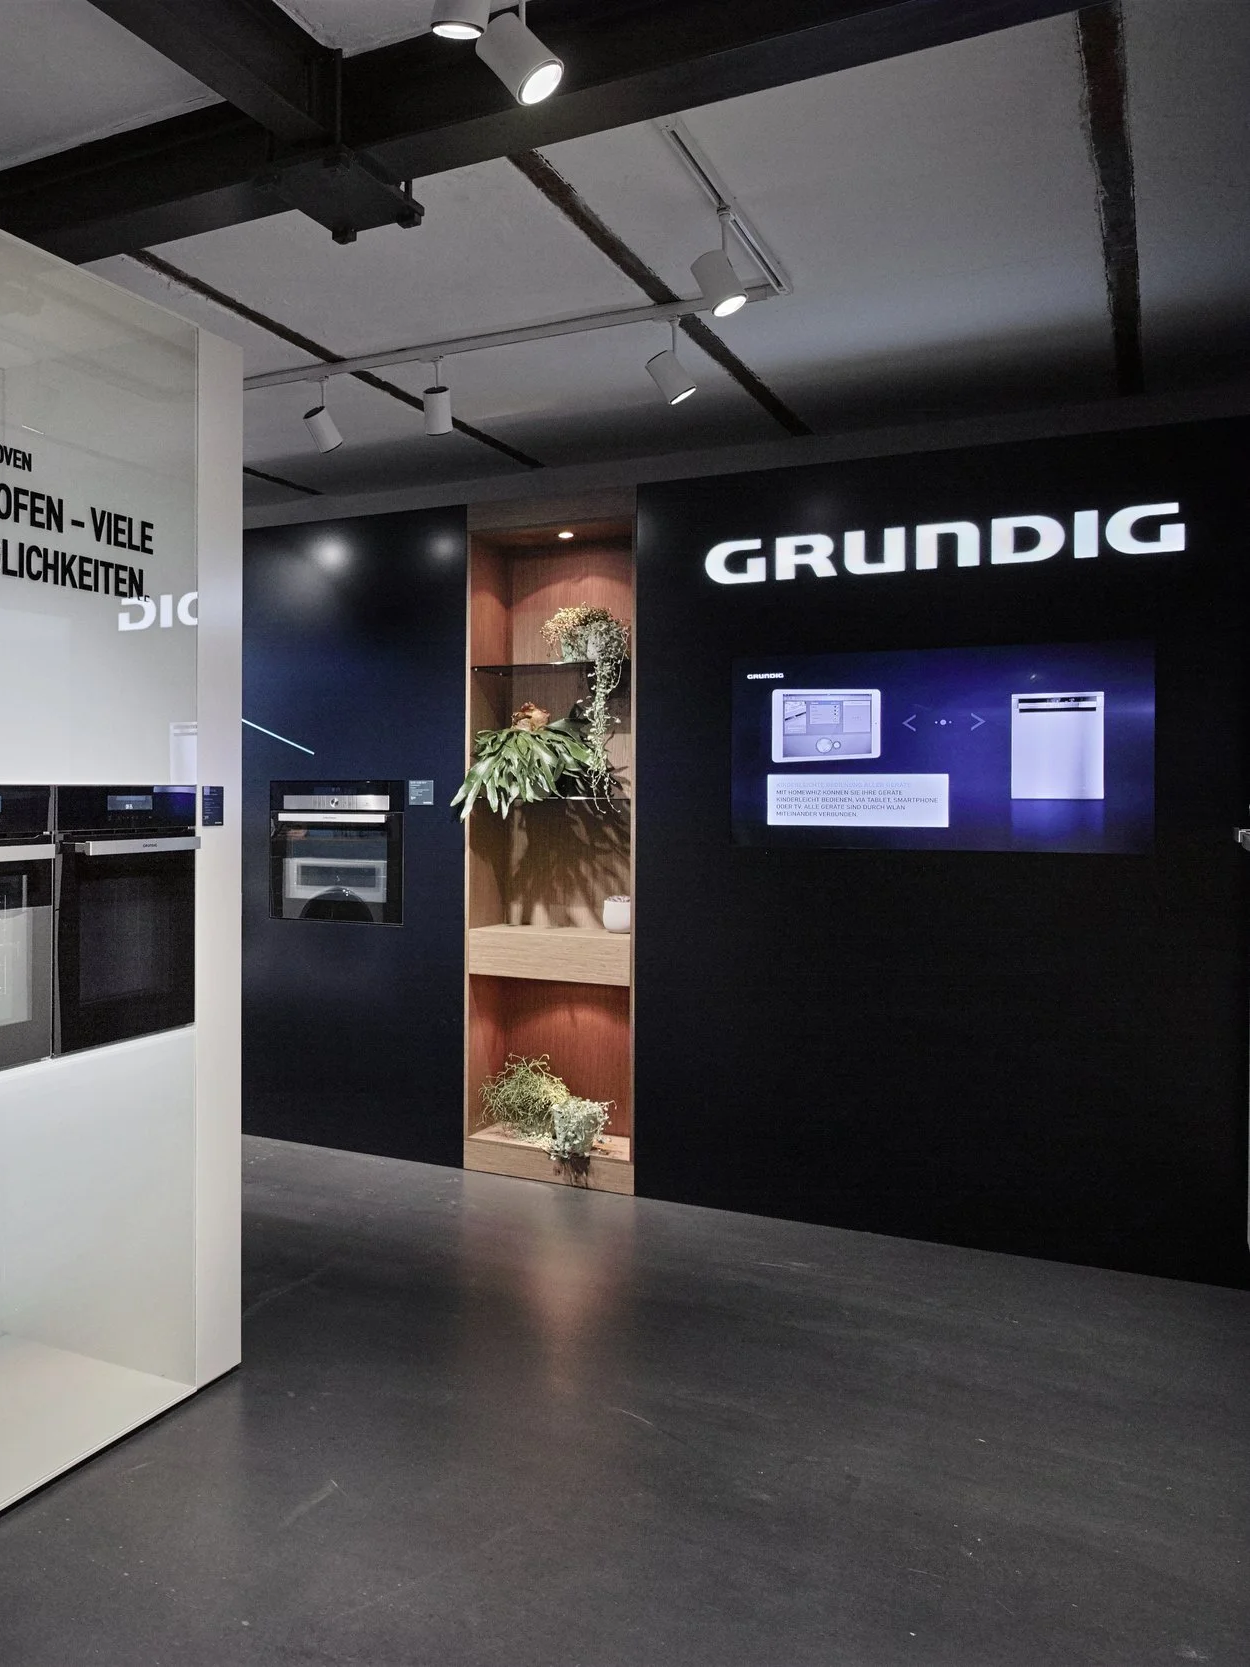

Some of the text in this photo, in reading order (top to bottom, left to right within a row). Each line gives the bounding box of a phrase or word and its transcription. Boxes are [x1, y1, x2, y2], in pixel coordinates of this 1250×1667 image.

[90, 506, 154, 555] VIELE
[704, 501, 1186, 585] GRUNDIG
[747, 672, 784, 680] GRUNDIG
